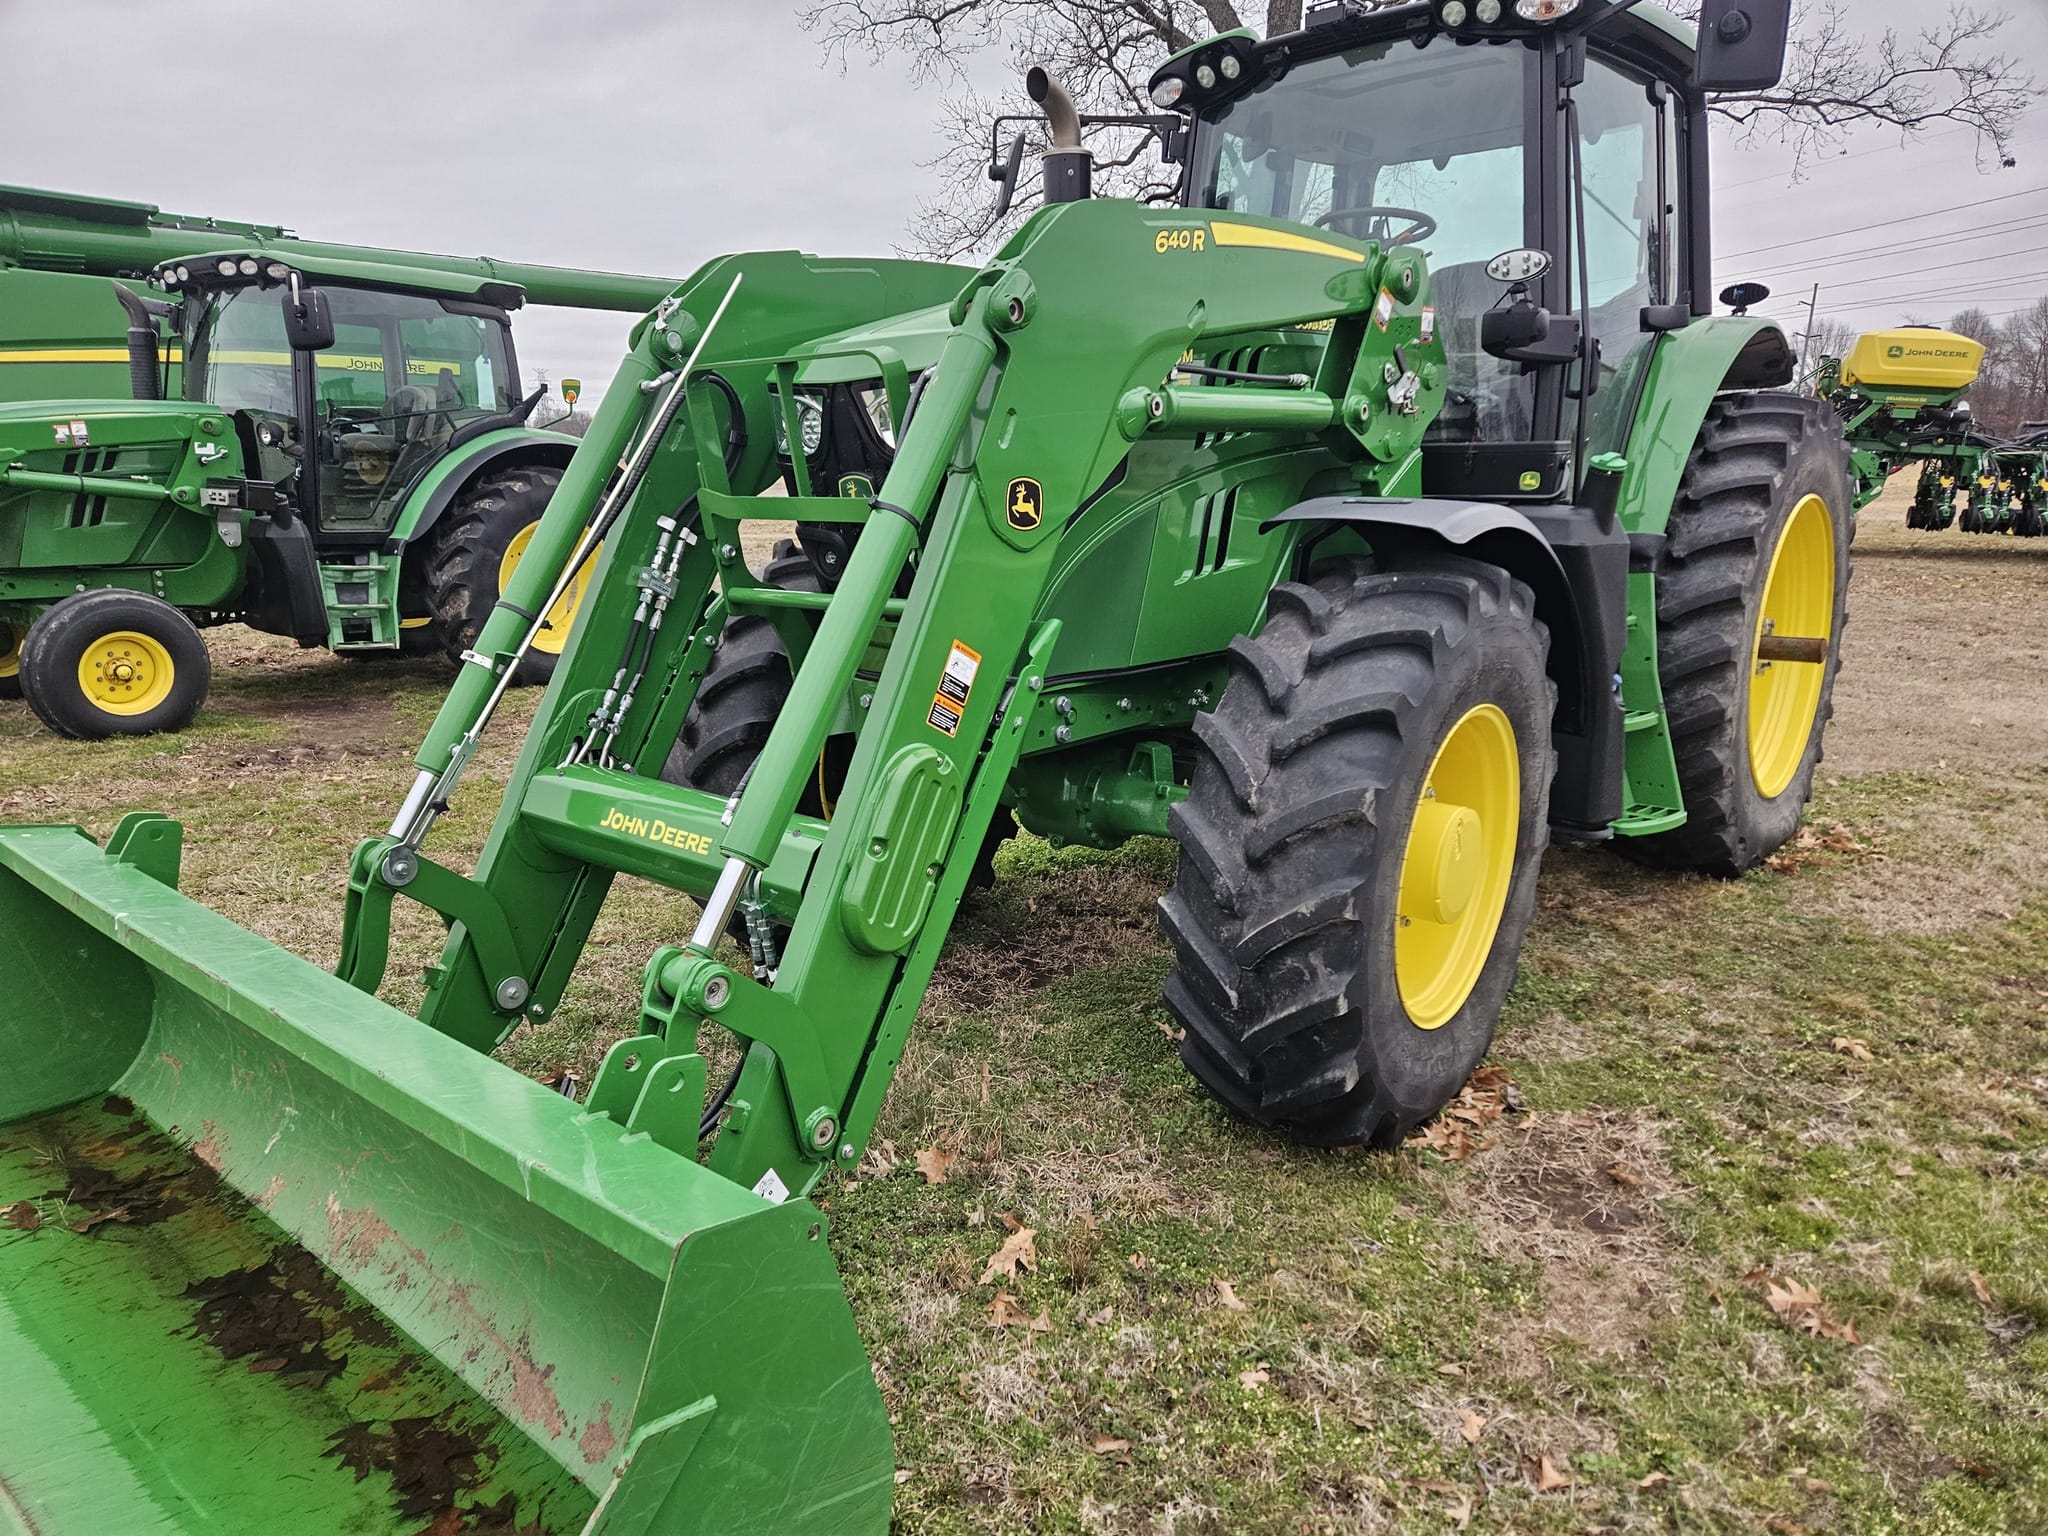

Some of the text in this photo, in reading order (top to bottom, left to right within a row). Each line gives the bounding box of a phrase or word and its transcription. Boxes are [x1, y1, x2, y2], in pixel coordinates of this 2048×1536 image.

[1905, 348, 1969, 358] JOHN DEERE
[346, 358, 383, 370] JOHN
[600, 807, 713, 857] JOHN DEERE
